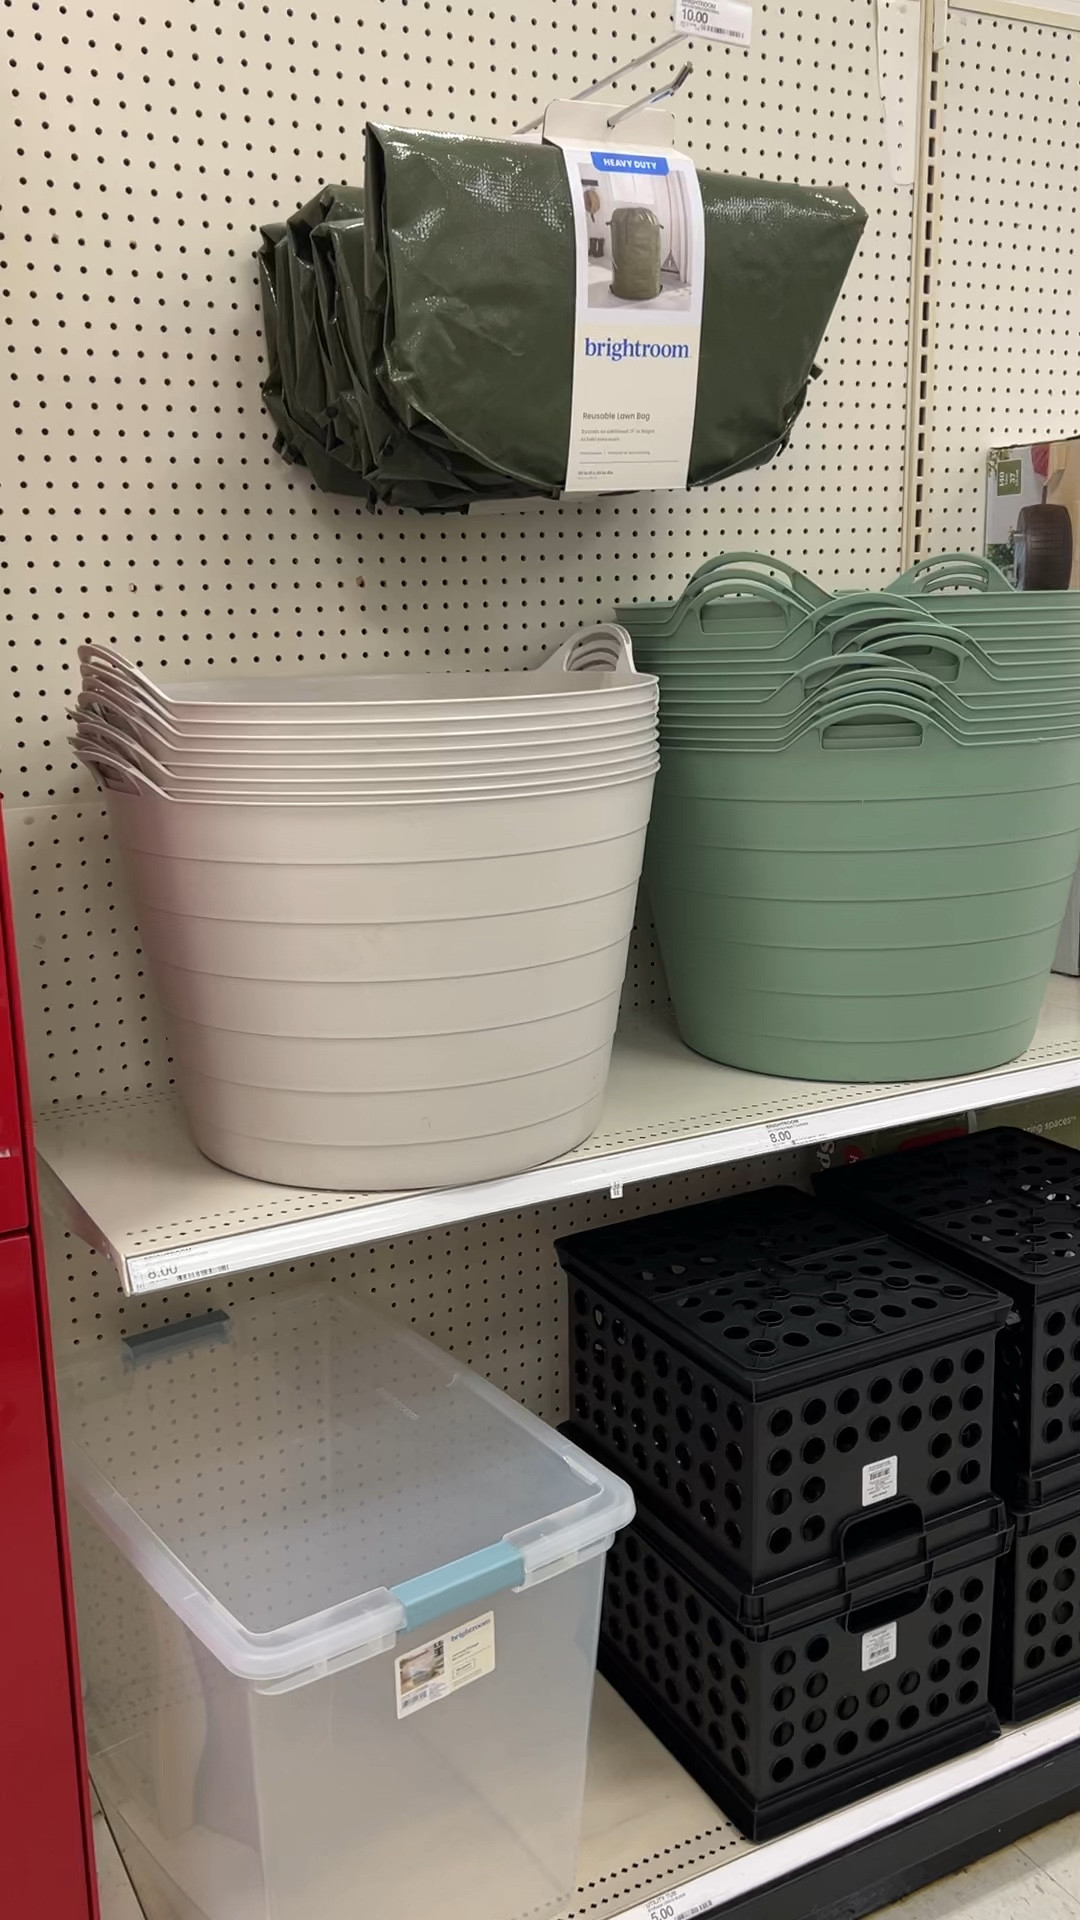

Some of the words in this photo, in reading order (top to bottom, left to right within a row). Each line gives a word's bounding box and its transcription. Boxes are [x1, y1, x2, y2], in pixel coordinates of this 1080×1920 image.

[682, 8, 708, 24] 10.00
[603, 158, 632, 168] HEAVY
[633, 160, 657, 170] DUTY
[585, 337, 689, 362] brightroom
[583, 412, 616, 421] Reusable
[617, 412, 635, 420] Lawn
[636, 412, 650, 422] Bag
[769, 1131, 792, 1143] 8.00
[651, 1905, 674, 1920] 5.00
